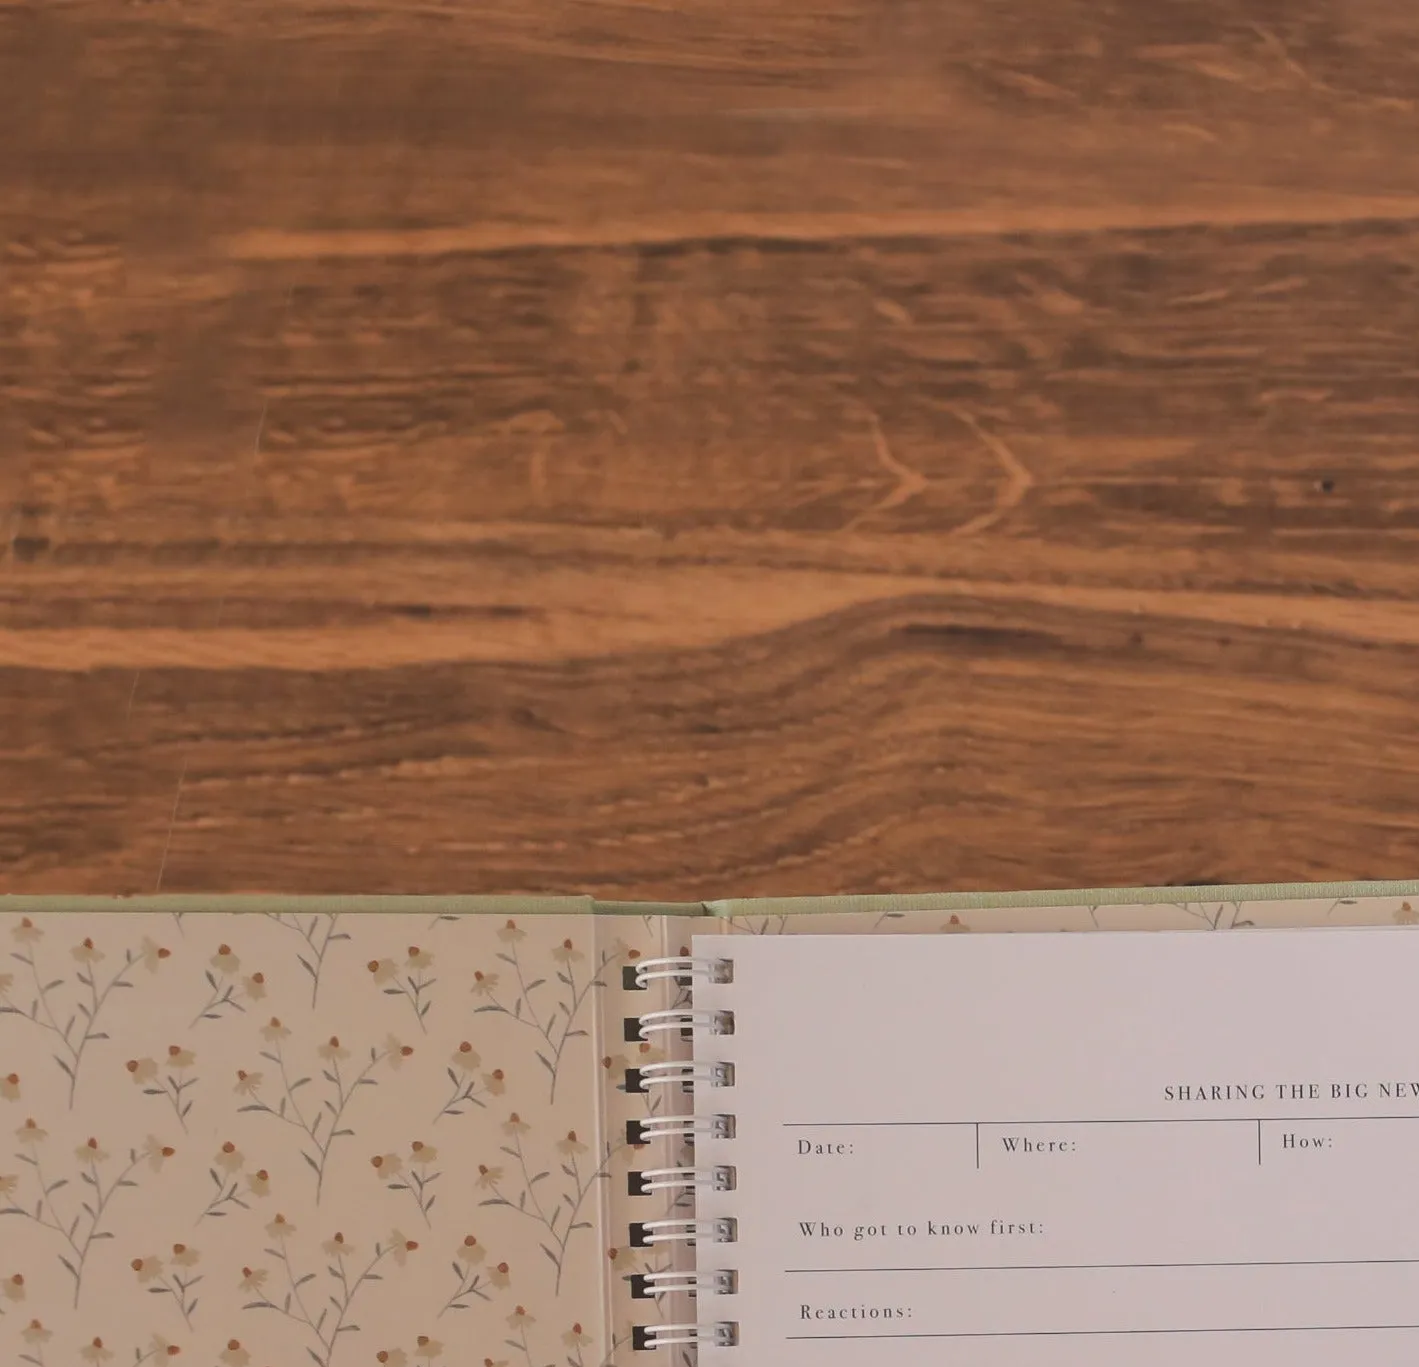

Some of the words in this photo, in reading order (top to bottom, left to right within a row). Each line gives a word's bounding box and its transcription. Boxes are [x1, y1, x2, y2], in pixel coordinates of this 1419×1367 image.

[1165, 1085, 1264, 1100] SHARING
[1276, 1084, 1319, 1099] THE
[1332, 1084, 1367, 1098] BIG
[798, 1140, 853, 1154] Date:
[1002, 1137, 1075, 1152] Where:
[1283, 1134, 1331, 1148] How:
[799, 1222, 843, 1237] Who
[854, 1225, 886, 1241] got
[898, 1225, 916, 1235] to
[928, 1221, 978, 1235] know
[991, 1220, 1042, 1234] first:
[800, 1305, 911, 1320] Reactions:
